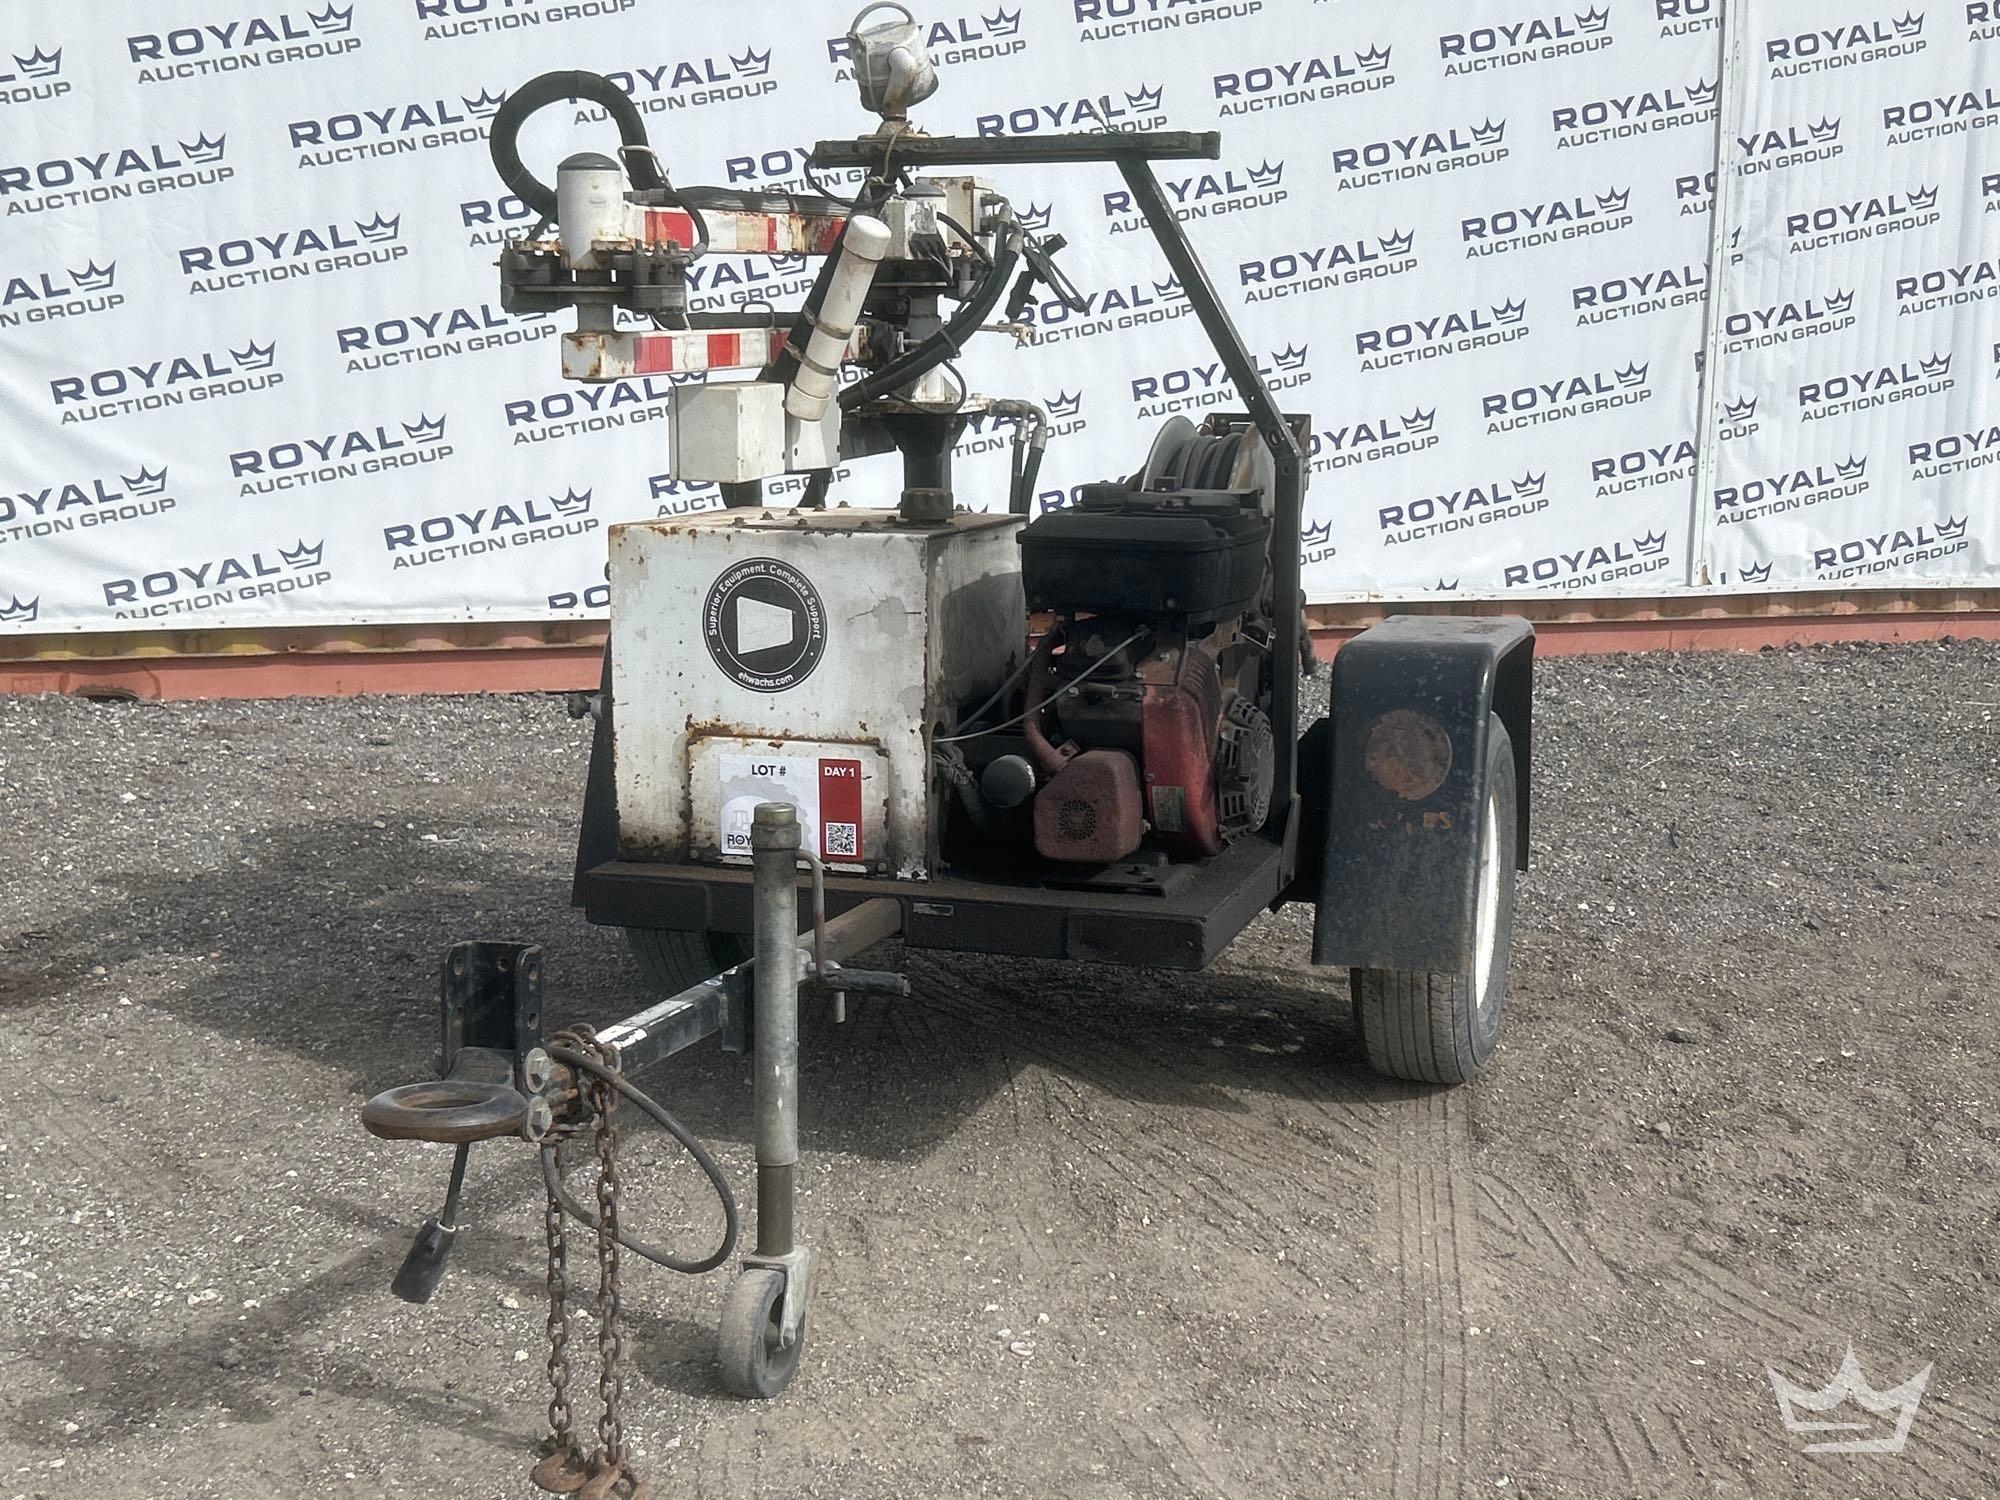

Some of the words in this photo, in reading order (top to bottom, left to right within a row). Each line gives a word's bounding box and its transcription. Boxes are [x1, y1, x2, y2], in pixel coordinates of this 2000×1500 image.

[127, 15, 310, 63] ROYAL
[425, 11, 540, 40] AUCTION
[546, 0, 636, 22] GROUP
[1081, 14, 1180, 42] AUCTION
[1185, 1, 1262, 24] GROUP
[1440, 16, 1575, 58] ROYAL
[1660, 17, 1719, 38] AUCTI
[1766, 21, 1892, 62] ROYAL
[138, 53, 261, 84] AUCTION
[266, 38, 361, 64] GROUP
[945, 40, 1026, 64] GROUP
[1445, 50, 1536, 77] AUCTION
[1542, 36, 1613, 59] GROUP
[1771, 53, 1856, 79] AUCTION
[1861, 40, 1926, 62] GROUP
[0, 81, 71, 104] ROUP
[691, 81, 777, 105] GROUP
[1214, 55, 1355, 99] ROYAL
[1219, 89, 1315, 117] AUCTION
[1320, 75, 1395, 99] GROUP
[288, 100, 464, 148] ROYAL
[1553, 89, 1685, 131] ROYAL
[299, 138, 416, 168] AUCTION
[1333, 130, 1470, 173] ROYAL
[1557, 122, 1647, 149] AUCTION
[1737, 126, 1808, 157] YAL
[1887, 120, 1967, 146] AUCTION
[0, 144, 182, 195] ROYAL
[1338, 162, 1431, 191] AUCTION
[1436, 148, 1509, 172] GROUP
[1776, 145, 1843, 168] GROUP
[7, 184, 132, 216] AUCTION
[138, 167, 234, 194] GROUP
[1103, 171, 1247, 216] RYAL
[1109, 205, 1207, 235] AUCON
[1212, 191, 1287, 215] GROUP
[1462, 198, 1595, 241] ROYAL
[1466, 230, 1557, 259] AUCTION
[1562, 216, 1633, 239] GROUP
[1787, 195, 1906, 237] ROYAL
[1790, 226, 1871, 254] AUCTION
[1876, 212, 1940, 235] GROUP
[179, 225, 357, 274] ROYAL
[190, 262, 310, 295] AUCTION
[315, 246, 408, 273] GROUP
[1239, 241, 1378, 286] ROYAL
[731, 279, 814, 305] GROUP
[1245, 274, 1339, 304] AUCTION
[1344, 259, 1417, 283] GROUP
[1572, 266, 1704, 310] ROYAL
[1896, 258, 2000, 300] ROYA
[26, 294, 124, 322] GROUP
[1118, 303, 1194, 329] GROUP
[1576, 298, 1666, 327] AUCTION
[1725, 301, 1824, 336] OYAL
[1899, 289, 1983, 316] AUCTION
[337, 304, 508, 353] ROYAL
[347, 341, 462, 373] AUCTION
[467, 325, 556, 351] GROUP
[1356, 310, 1491, 355] ROYAL
[1360, 343, 1452, 372] AUCTION
[1458, 327, 1529, 351] GROUP
[1724, 330, 1788, 355] CTION
[1792, 316, 1855, 339] GROUP
[50, 353, 232, 405] ROYAL
[62, 391, 183, 425] AUCTION
[189, 373, 283, 401] GROUP
[1131, 355, 1272, 401] ROYL
[1137, 389, 1233, 419] AUCTION
[1268, 372, 1311, 391] OUP
[1482, 373, 1614, 418] ROYAL
[1799, 363, 1919, 406] ROYAL
[505, 377, 669, 427] ROYAL
[1487, 405, 1576, 435] AUCTION
[1581, 389, 1651, 414] GROUP
[1801, 394, 1884, 422] AUCTION
[1888, 379, 1954, 402] GROUP
[514, 414, 624, 445] AUCTION
[952, 438, 1004, 458] TION
[1719, 423, 1759, 441] OUP
[230, 427, 404, 477] ROYAL
[240, 464, 357, 497] AUCTION
[363, 446, 453, 473] GROUP
[1309, 452, 1362, 474] TION
[1367, 436, 1439, 461] GROUP
[1592, 441, 1698, 481] ROYA
[1912, 453, 1993, 480] AUCTION
[1596, 468, 1683, 498] AUCTION
[1714, 466, 1835, 510] ROYAL
[1717, 497, 1799, 526] AUCTION
[1804, 482, 1869, 505] GROUP
[0, 518, 74, 543] TION
[80, 498, 176, 527] GROUP
[384, 500, 551, 550] ROYAL
[657, 494, 720, 517] AUCT
[1379, 483, 1512, 529] ROYAL
[1384, 516, 1474, 546] AUCTION
[1479, 499, 1549, 524] GROUP
[393, 536, 506, 570] AUCTION
[512, 519, 599, 545] GROUP
[1504, 542, 1633, 587] ROYAL
[1814, 526, 1934, 570] ROYAL
[1904, 541, 1968, 564] GROUP
[103, 554, 281, 606] ROYAL
[239, 572, 331, 600] GROUP
[1601, 557, 1669, 581] GROUP
[709, 591, 722, 636] Superior
[718, 564, 766, 592] Equipment
[769, 565, 808, 596] Complete
[806, 597, 822, 640] Support
[738, 671, 794, 687] ehwachs.com
[751, 764, 776, 776] LOT
[779, 766, 786, 776] #
[824, 766, 847, 777] DAY
[849, 767, 856, 778] 1
[727, 834, 752, 846] ROY
